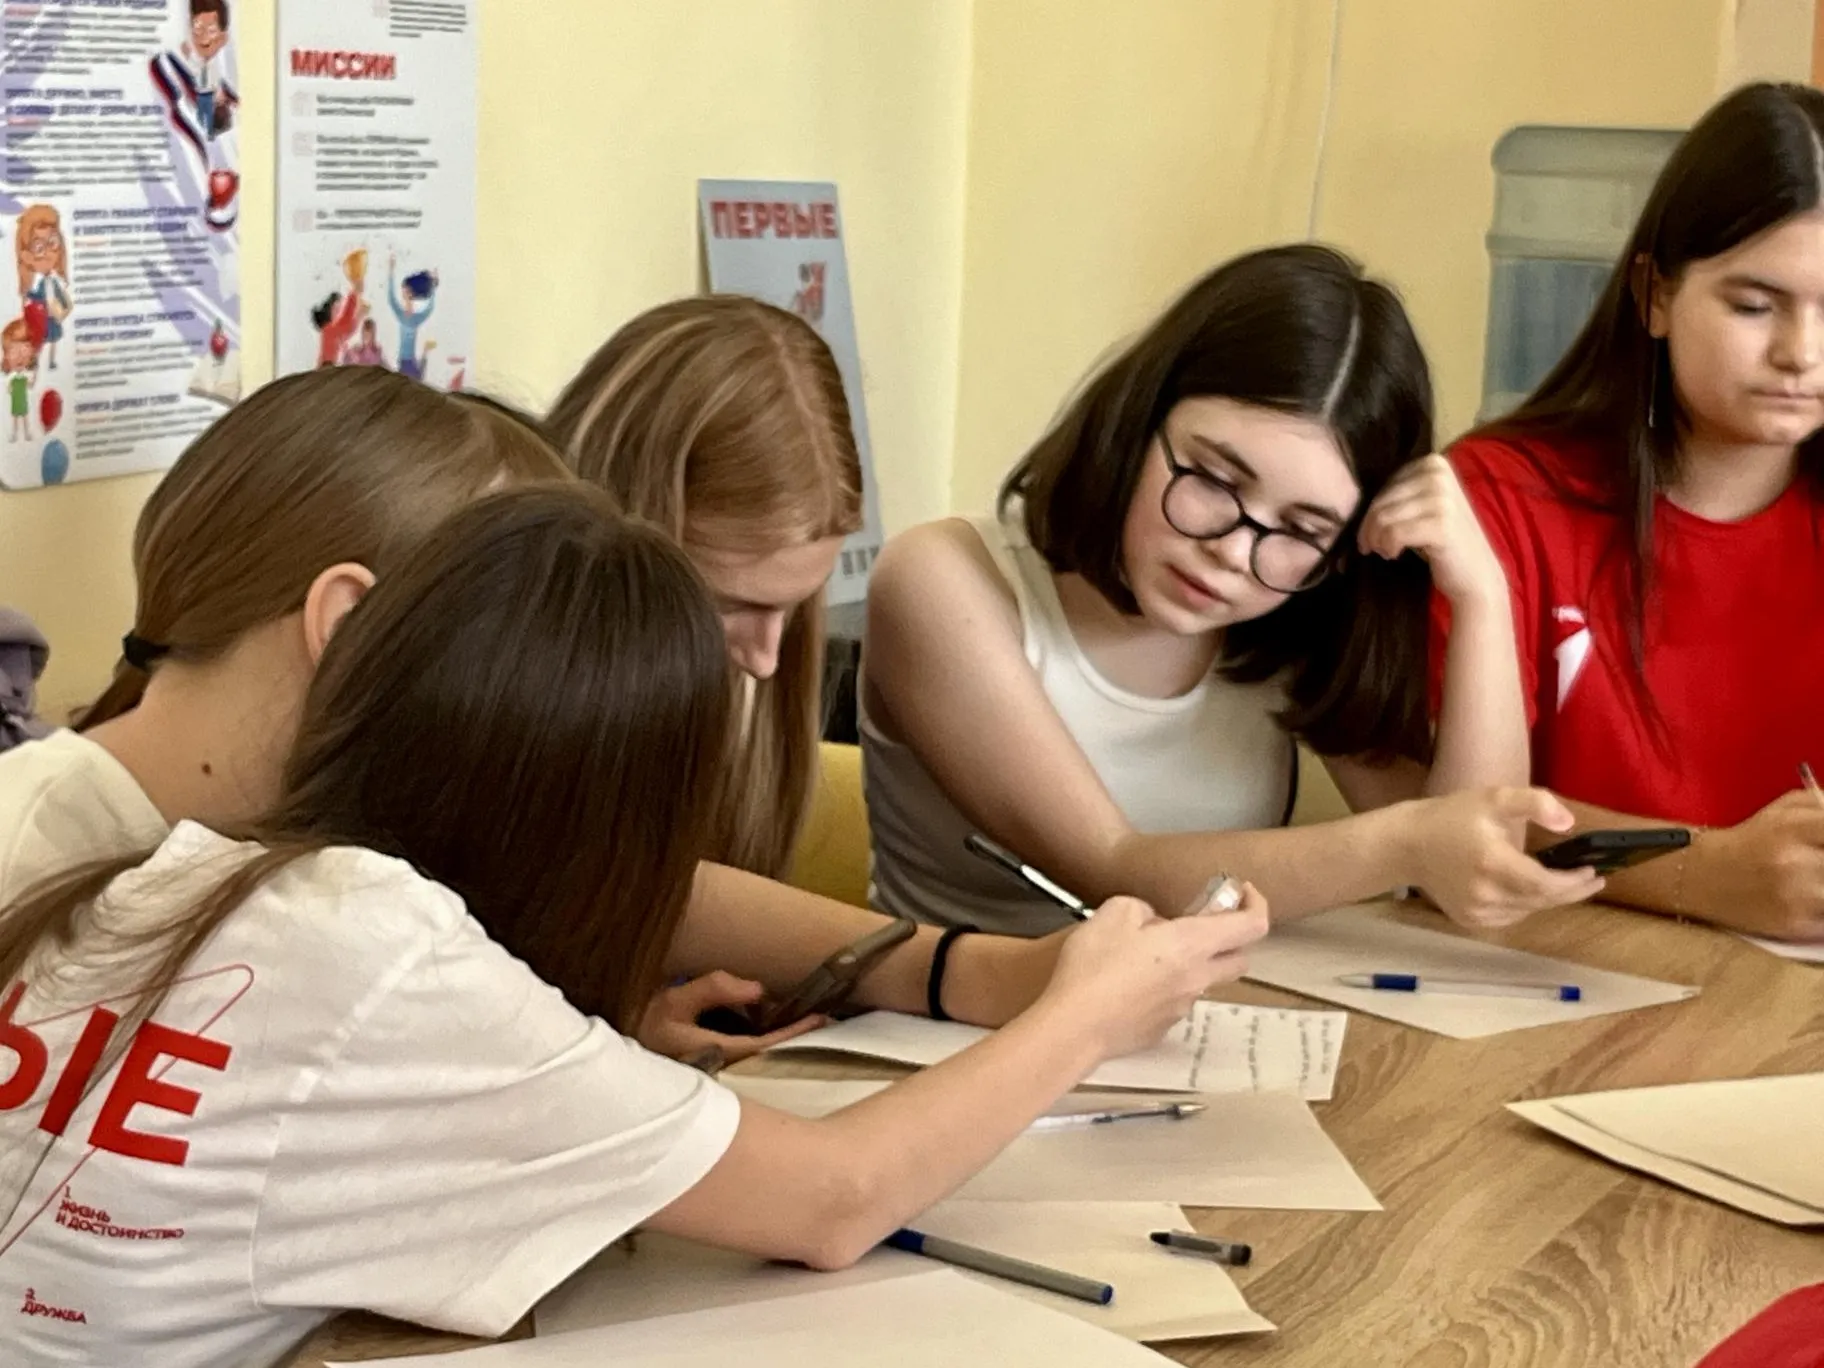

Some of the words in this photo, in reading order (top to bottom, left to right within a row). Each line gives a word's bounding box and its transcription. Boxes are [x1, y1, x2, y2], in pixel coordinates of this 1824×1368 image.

[290, 49, 397, 80] МИССИИ
[710, 200, 839, 240] ПЕРВЫЕ
[59, 1199, 111, 1223] ЖИЗНЬ
[67, 1216, 185, 1240] ДОСТОИНСТВО
[20, 1300, 88, 1325] ДРУЖБА
